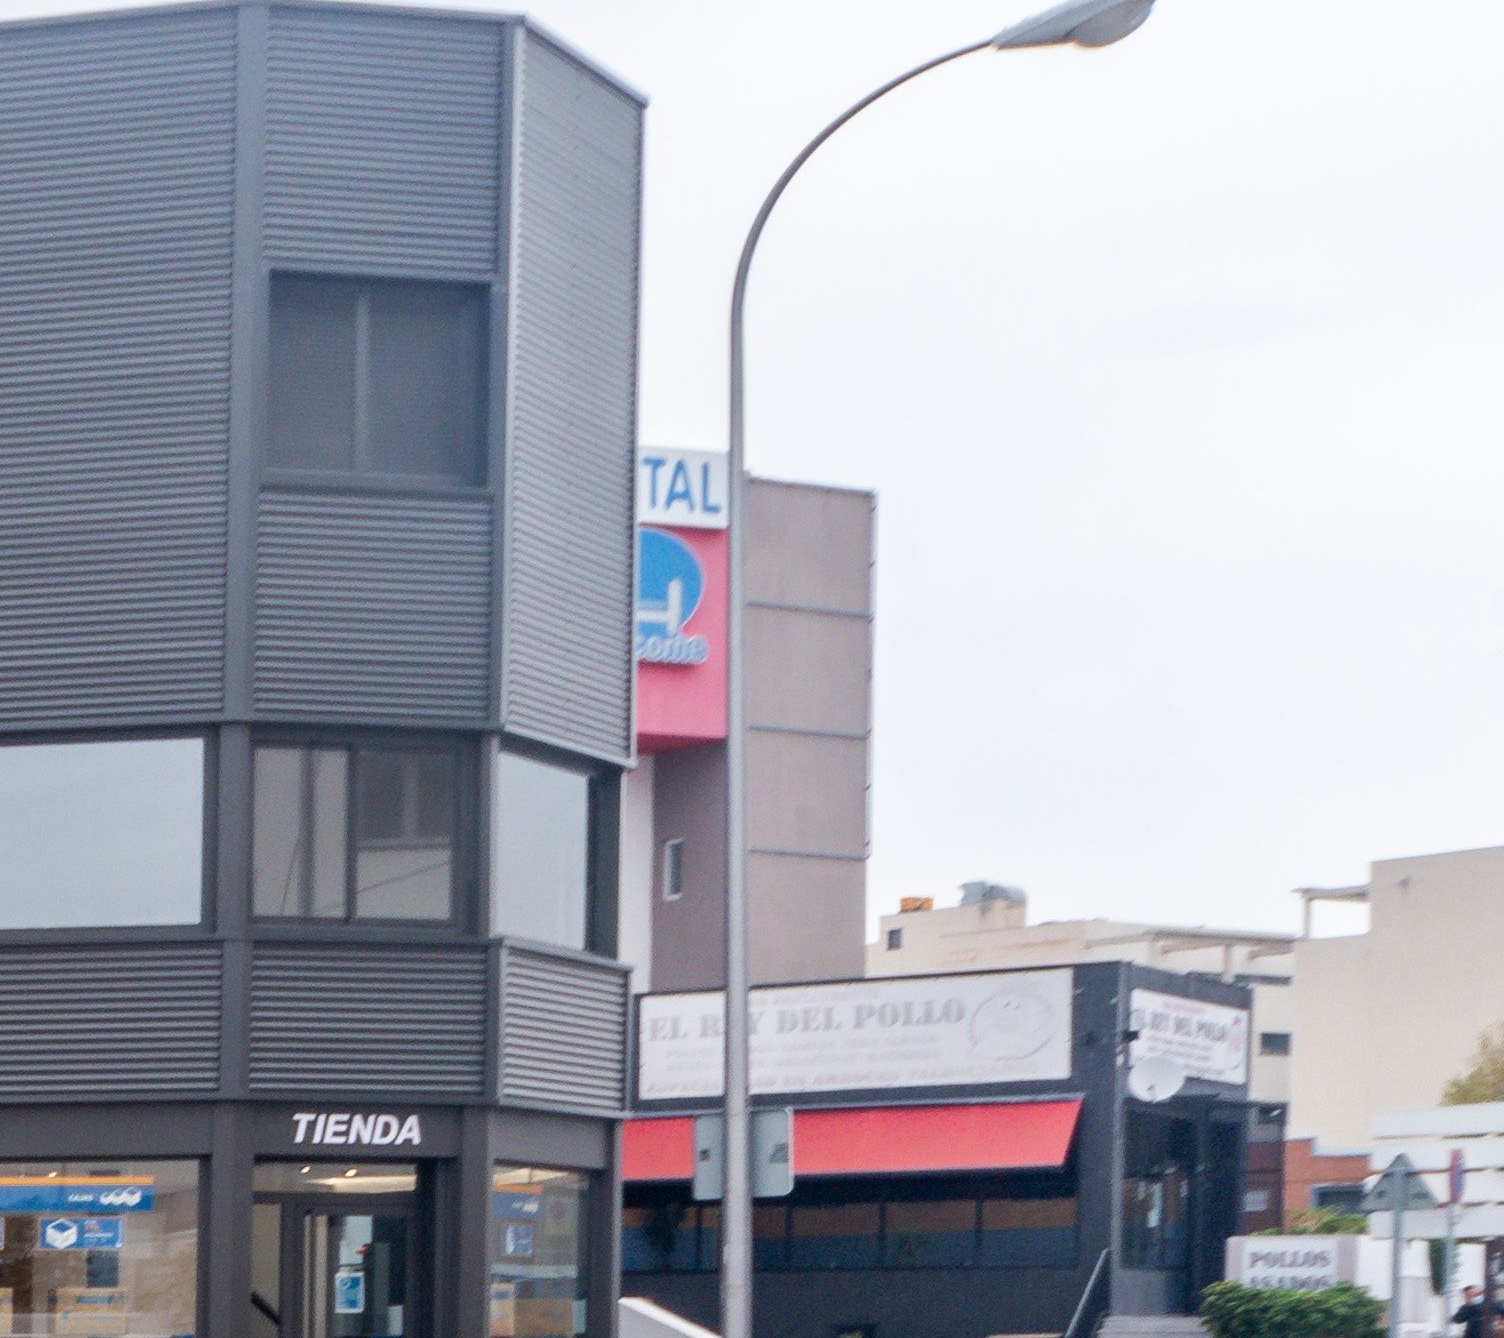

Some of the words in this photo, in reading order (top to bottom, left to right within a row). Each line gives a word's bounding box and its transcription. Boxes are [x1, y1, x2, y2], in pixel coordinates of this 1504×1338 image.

[648, 1017, 688, 1042] EL
[775, 1004, 844, 1035] DEL
[851, 996, 967, 1030] POLLO
[292, 1113, 422, 1146] TIENDA
[1248, 1250, 1331, 1268] POLLOS
